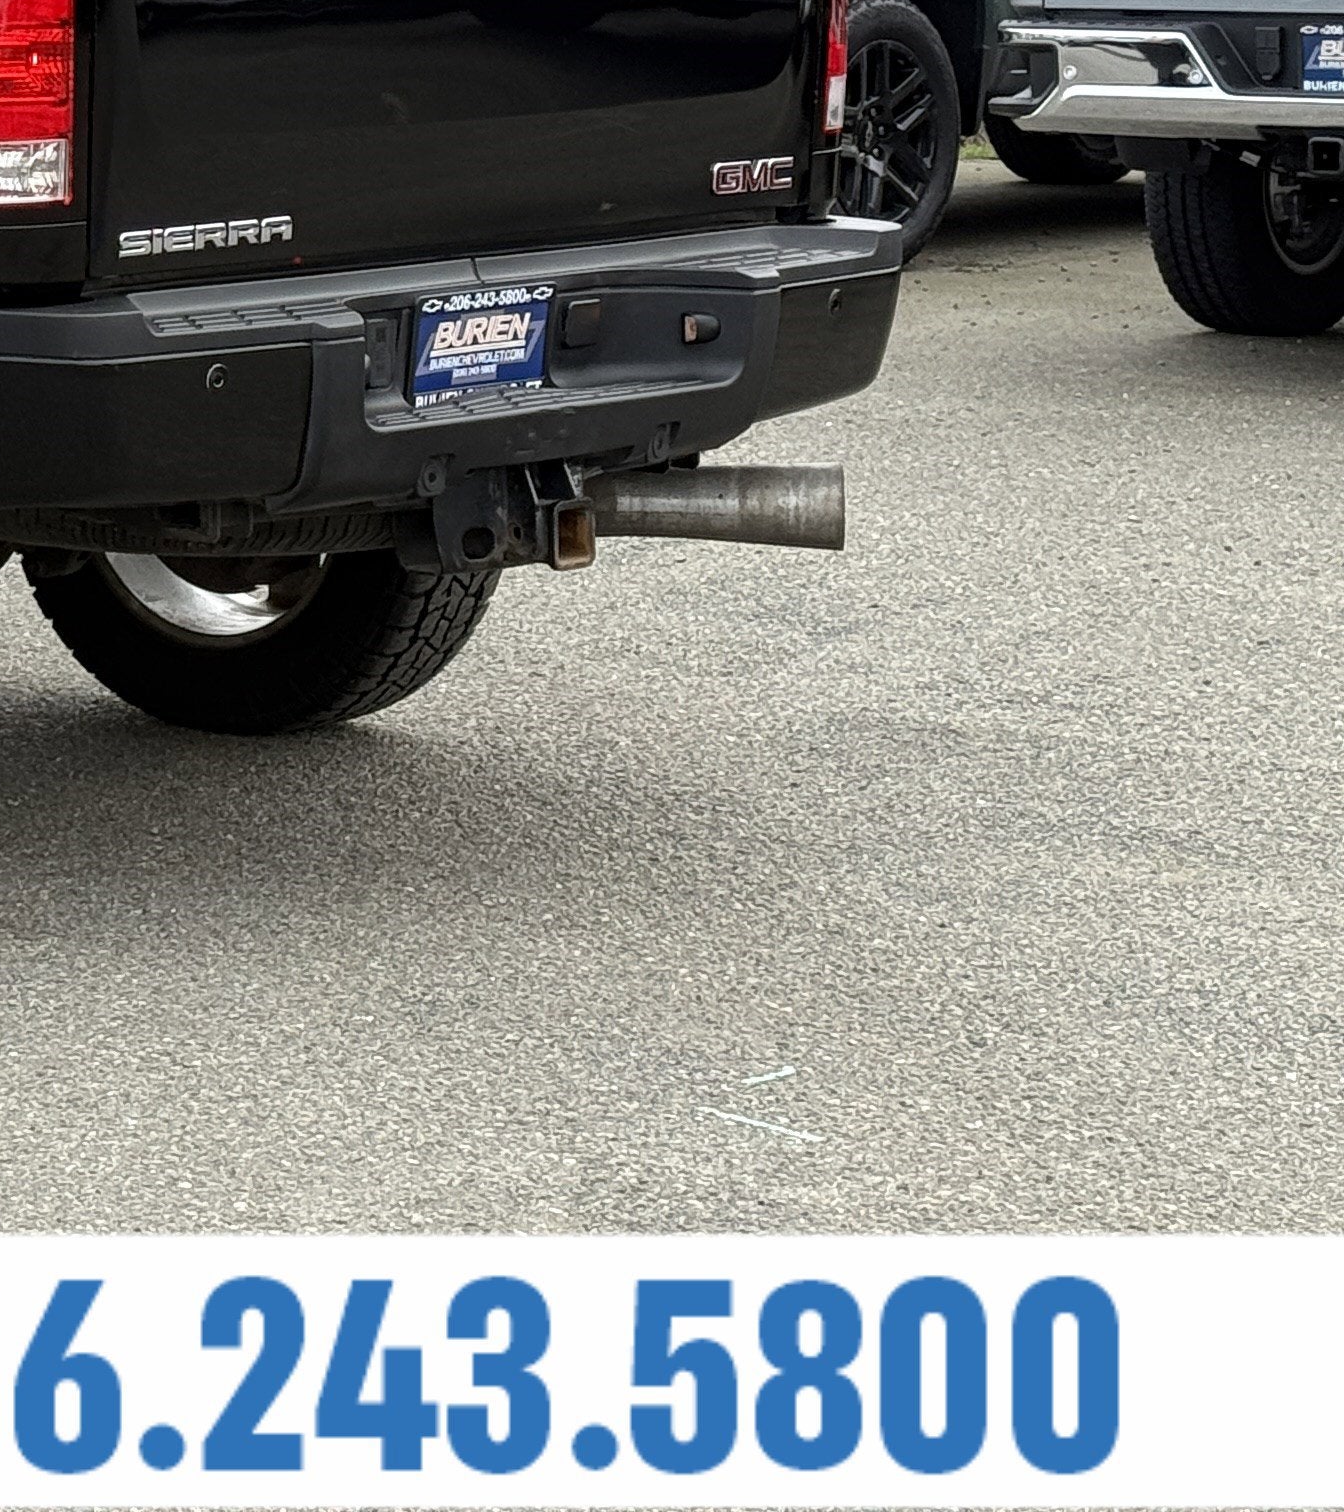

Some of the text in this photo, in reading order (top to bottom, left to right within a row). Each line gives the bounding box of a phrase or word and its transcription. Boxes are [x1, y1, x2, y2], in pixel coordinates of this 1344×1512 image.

[711, 156, 794, 195] GMC
[118, 215, 293, 258] SIERRA
[433, 312, 531, 349] BURIEN
